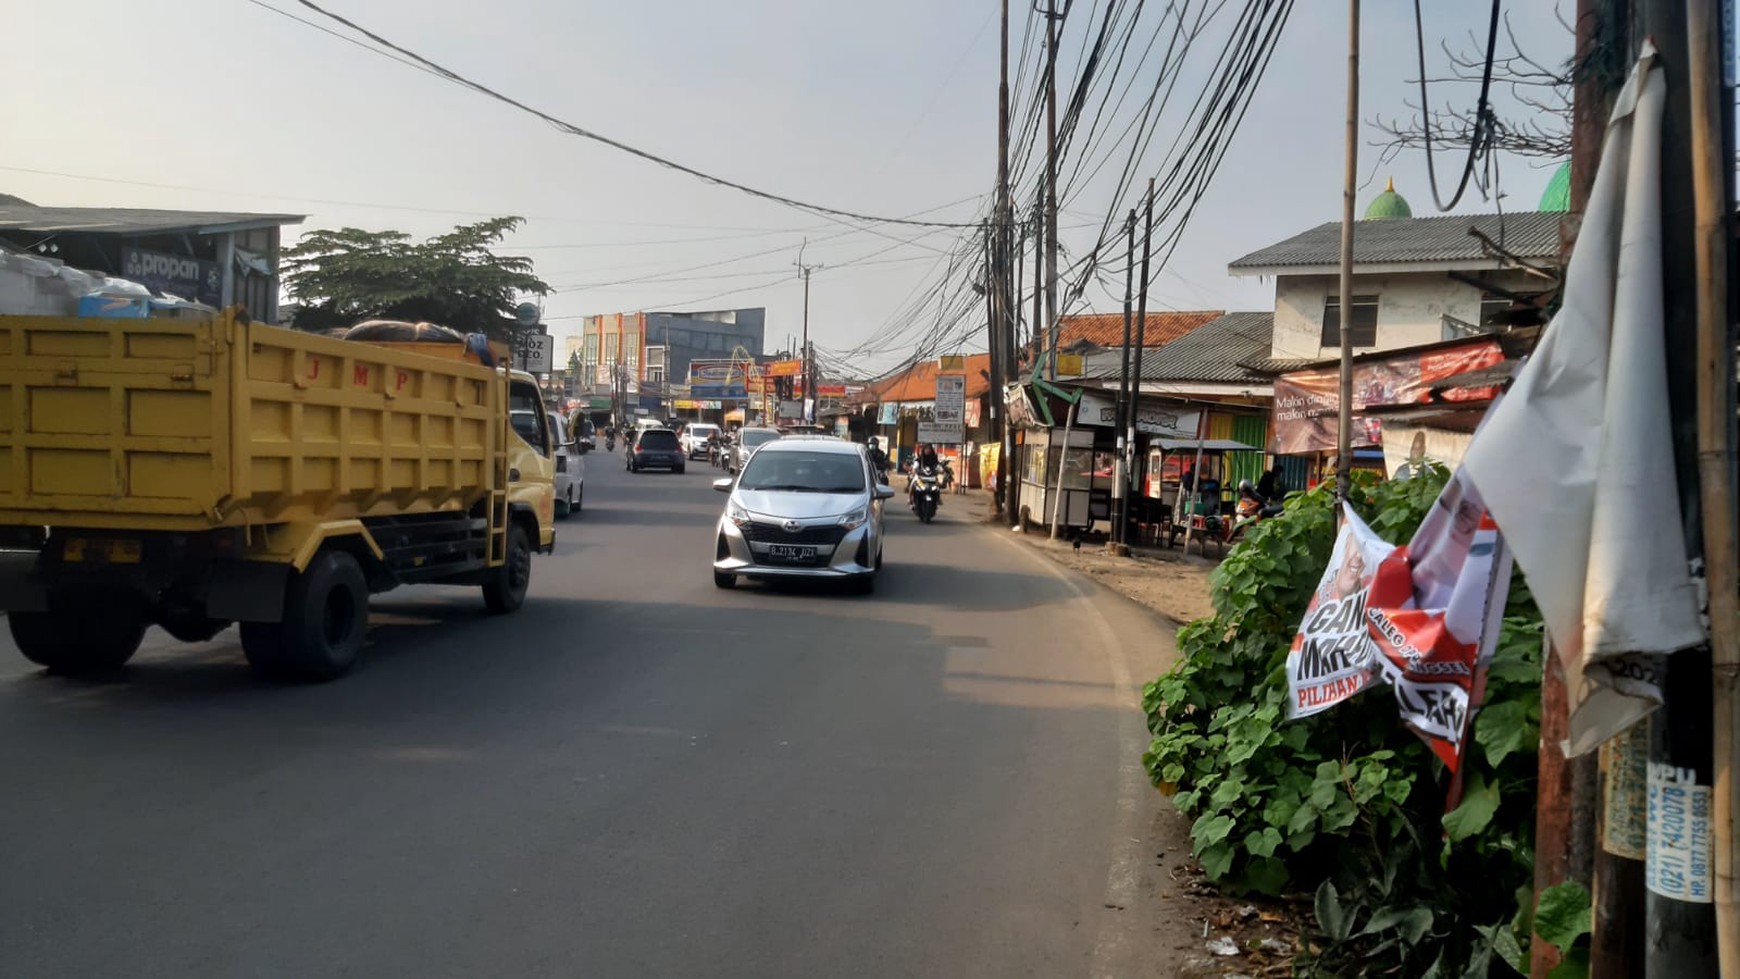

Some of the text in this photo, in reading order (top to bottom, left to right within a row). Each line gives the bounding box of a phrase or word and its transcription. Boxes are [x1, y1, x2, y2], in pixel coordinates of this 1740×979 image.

[142, 253, 199, 280] propan
[307, 358, 408, 391] J M P
[1276, 395, 1305, 409] Makin
[1277, 408, 1306, 421] makin
[1368, 607, 1405, 645] CALEG
[1692, 820, 1707, 846] 7755
[1660, 854, 1685, 895] (021)
[1692, 850, 1706, 876] 0877
[1691, 880, 1705, 897] HP.
